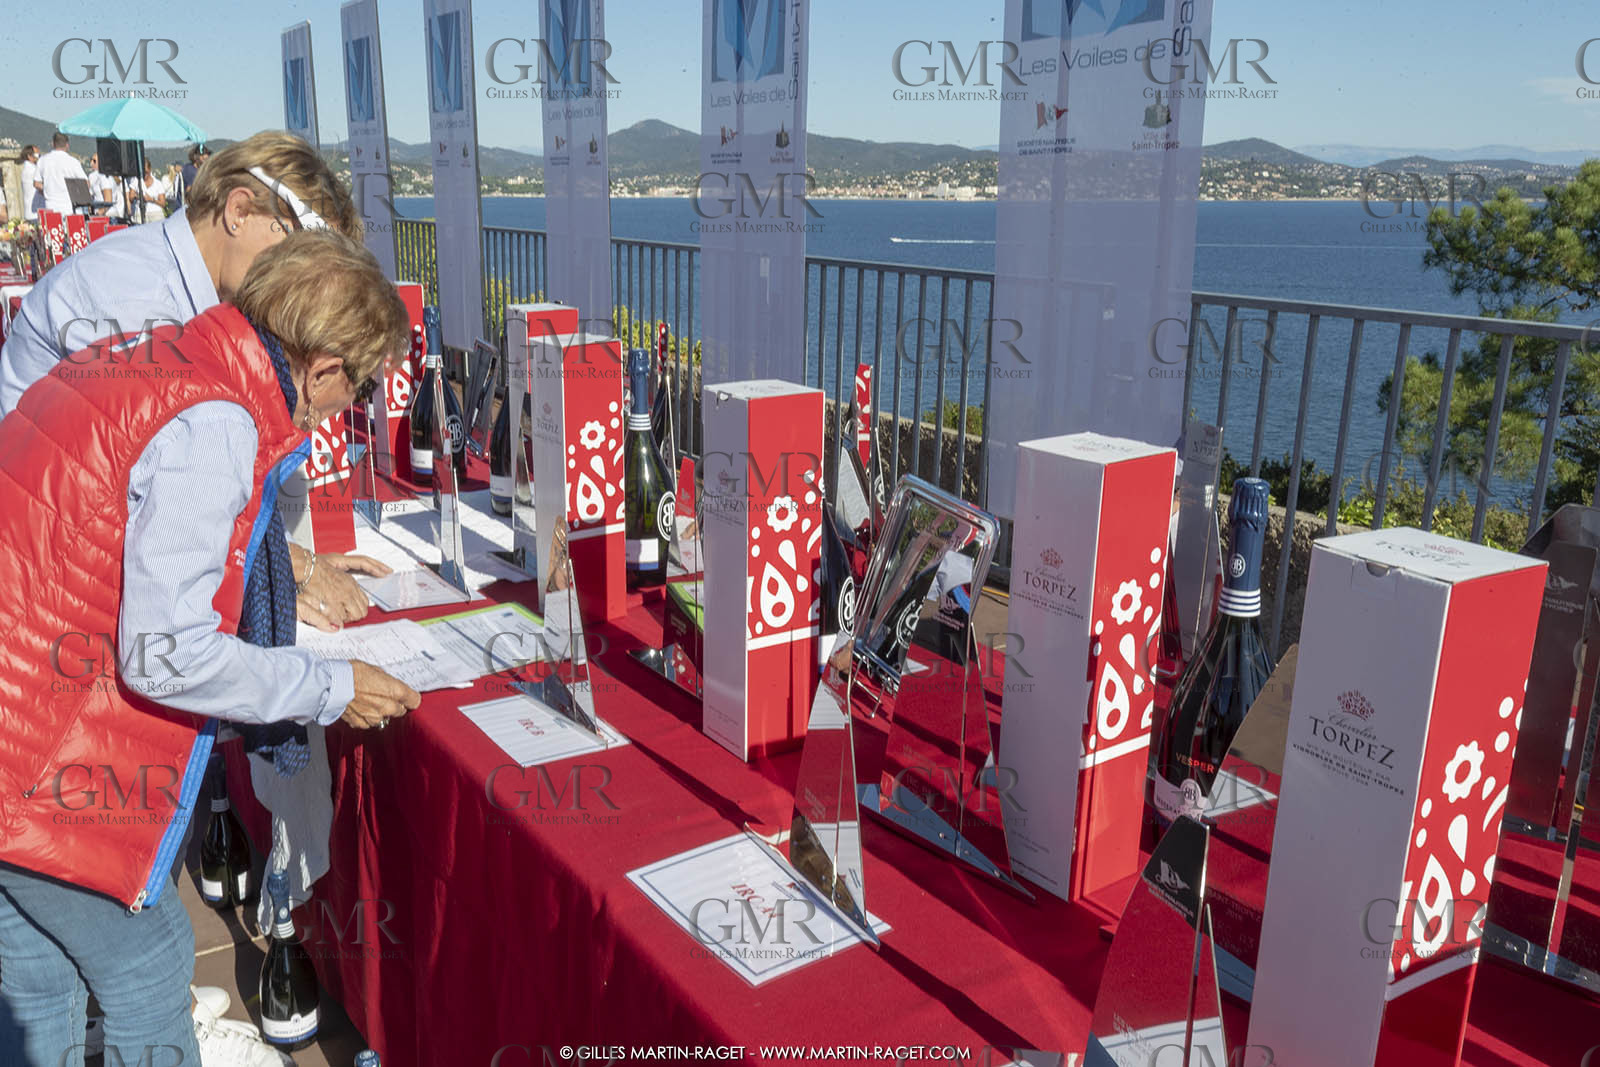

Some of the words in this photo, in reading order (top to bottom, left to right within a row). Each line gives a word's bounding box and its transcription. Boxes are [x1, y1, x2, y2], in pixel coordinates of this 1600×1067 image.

[1019, 57, 1056, 77] Les
[1062, 46, 1128, 70] Voiles
[1134, 39, 1166, 62] de
[710, 93, 731, 108] Les
[1024, 570, 1077, 602] TORPEZ
[1309, 716, 1395, 770] TORPEZ
[1176, 752, 1214, 774] VESPER
